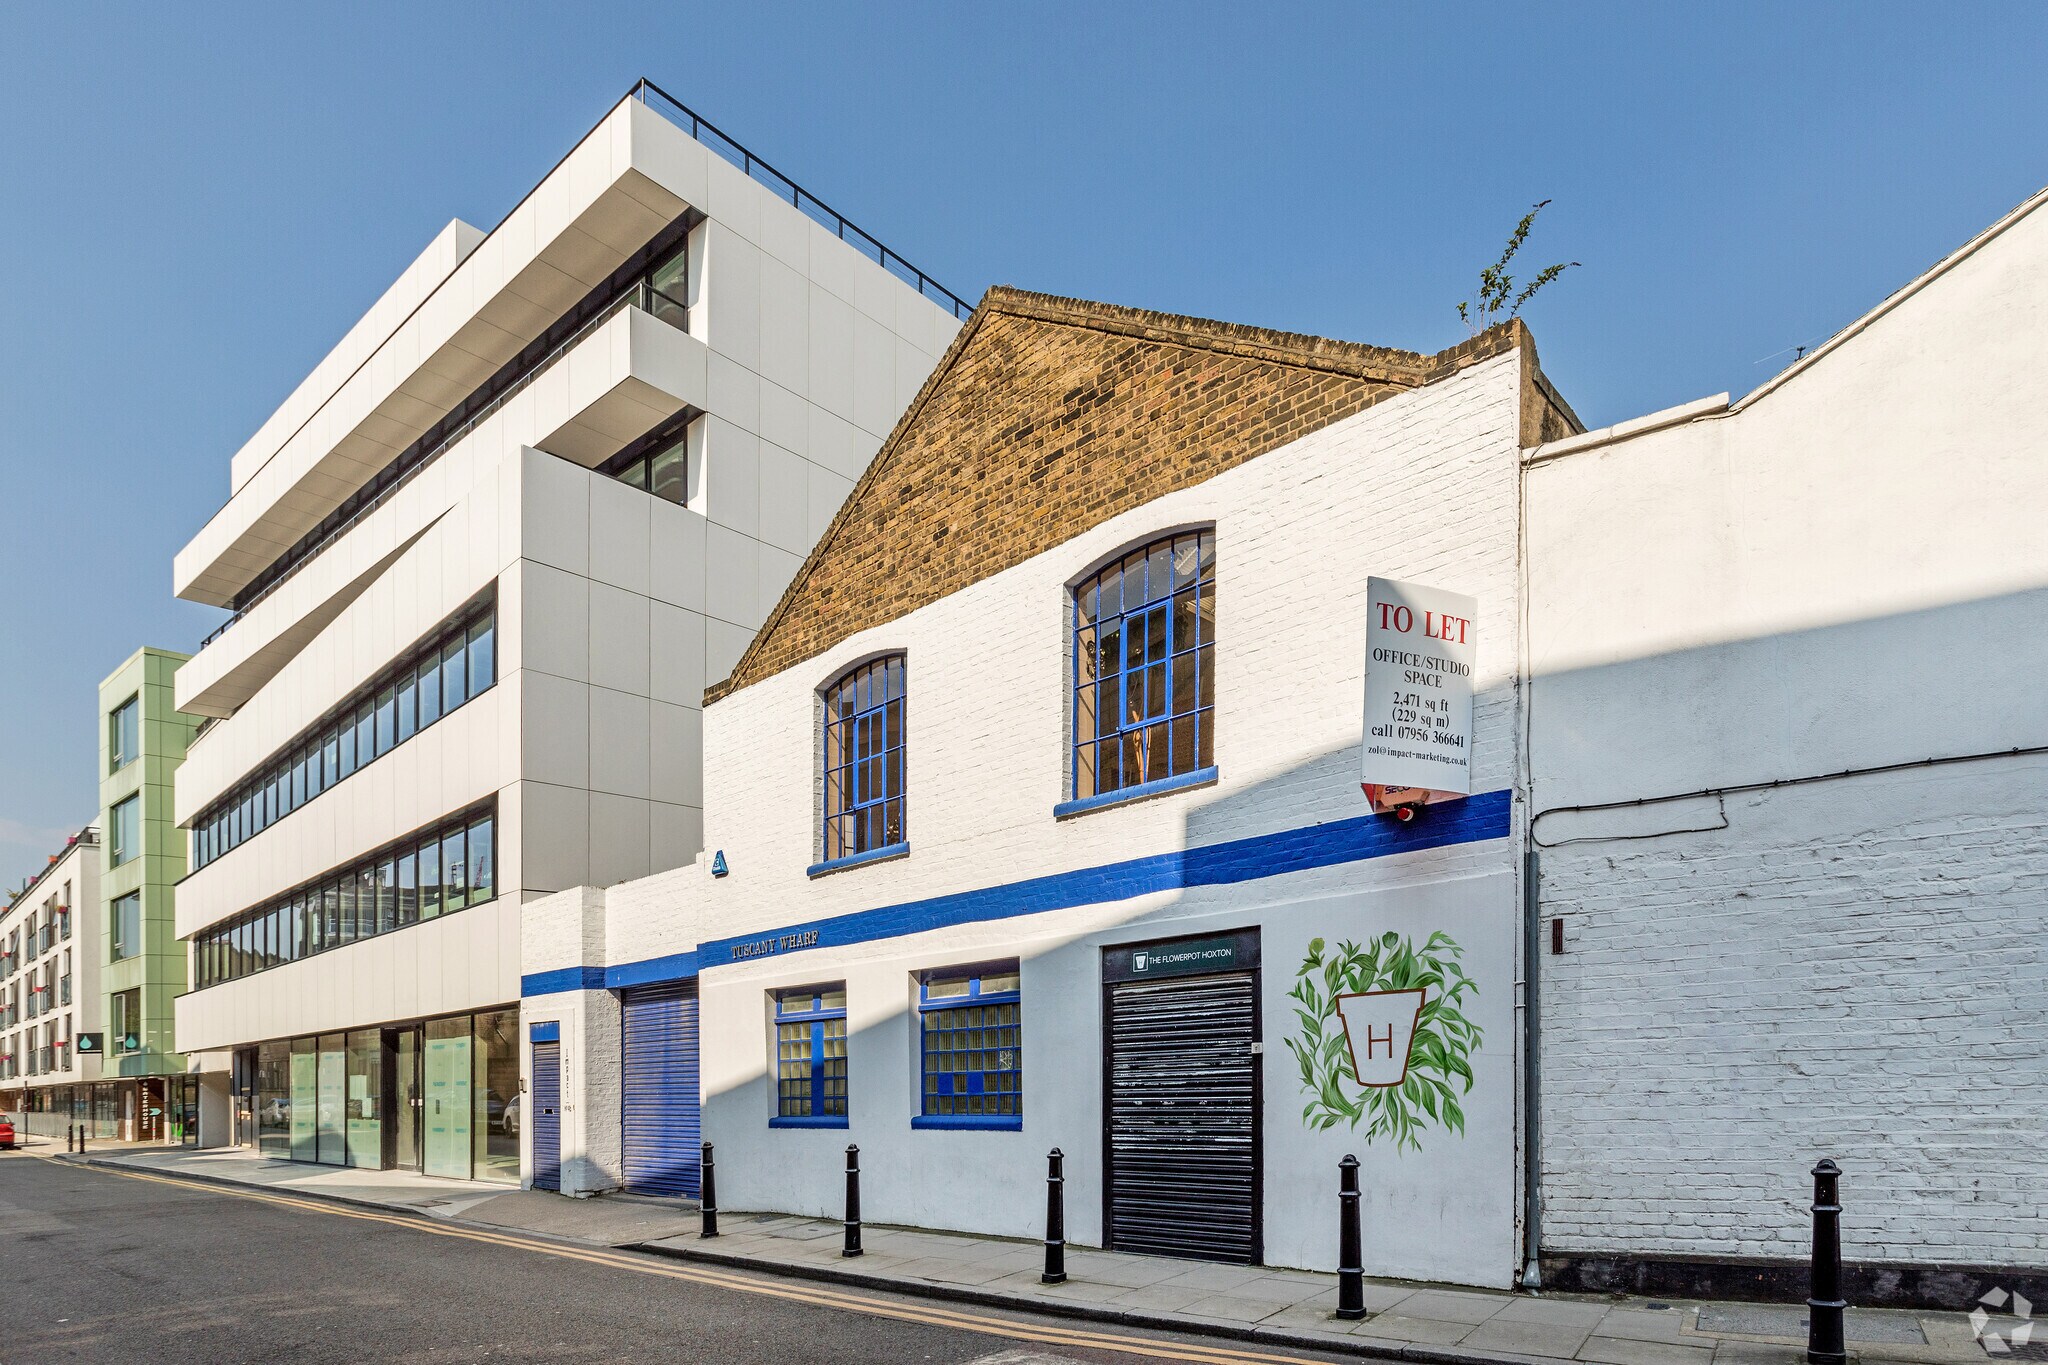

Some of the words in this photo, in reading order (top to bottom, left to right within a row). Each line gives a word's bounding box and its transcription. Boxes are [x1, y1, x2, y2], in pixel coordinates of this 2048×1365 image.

[1376, 602, 1413, 633] TO
[1423, 610, 1470, 645] LET
[1372, 647, 1470, 677] OFFICE/STUDIO
[1404, 669, 1443, 689] SPACE
[1393, 691, 1420, 708] 2,471
[1424, 699, 1436, 713] sq
[1440, 698, 1449, 712] ft
[1392, 706, 1417, 723] (229
[1420, 714, 1432, 728] sq
[1436, 714, 1450, 730] m)
[1371, 723, 1393, 738] call
[1398, 725, 1429, 742] 07956
[1432, 730, 1465, 748] 366641
[1367, 745, 1468, 767] zol@impact-marketing.co.uk
[731, 939, 776, 959] TUSCANY
[780, 930, 819, 950] WHARF
[1162, 952, 1200, 963] FLOWERPOT
[1202, 949, 1232, 959] HOXTON
[1367, 1023, 1393, 1060] H
